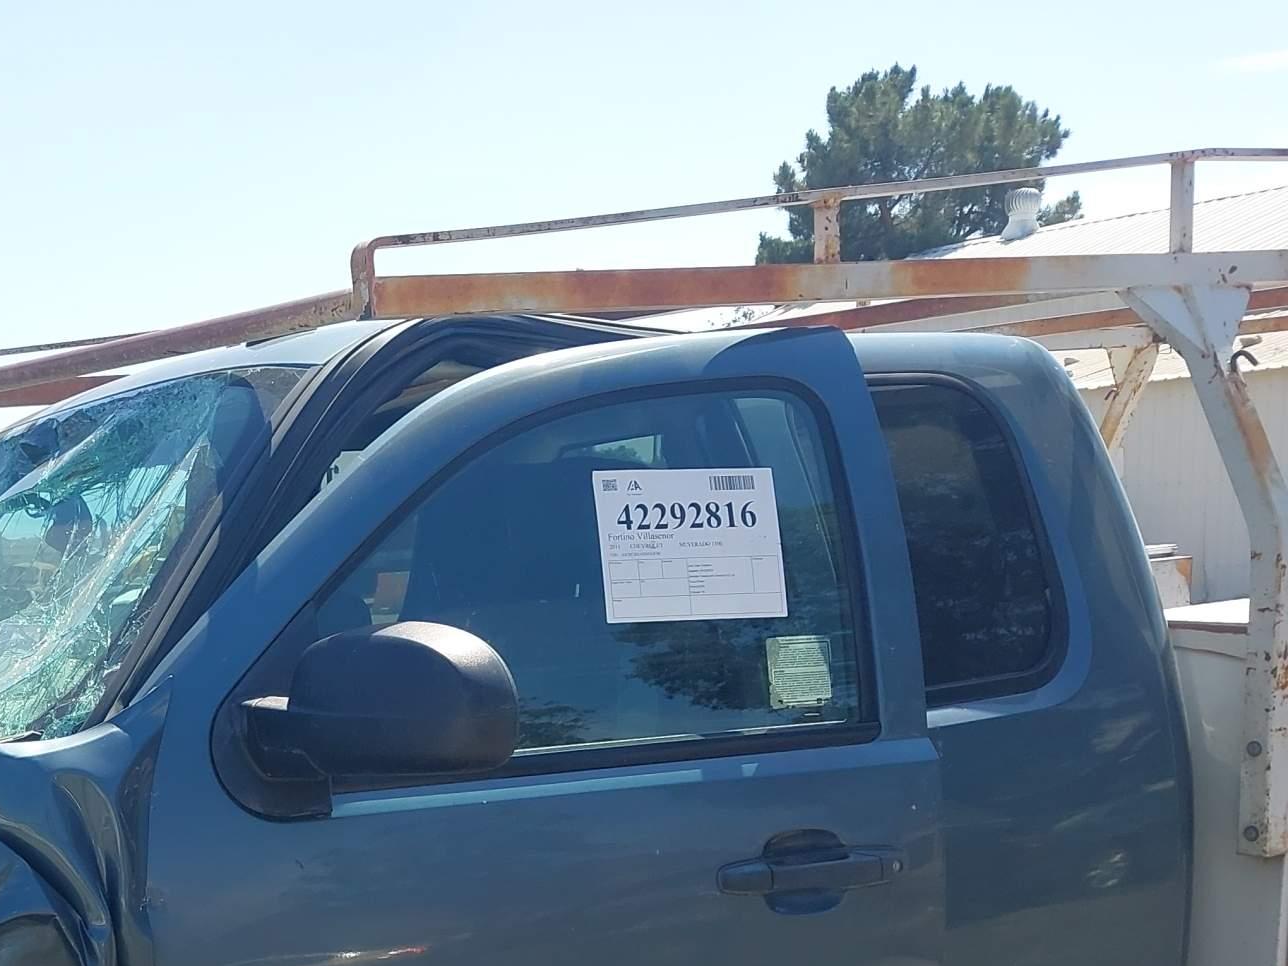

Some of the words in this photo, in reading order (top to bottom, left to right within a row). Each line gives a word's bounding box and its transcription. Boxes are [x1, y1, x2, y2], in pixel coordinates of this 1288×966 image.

[616, 500, 758, 531] 42292816
[607, 532, 635, 542] Fortino
[636, 531, 675, 541] Villasenor
